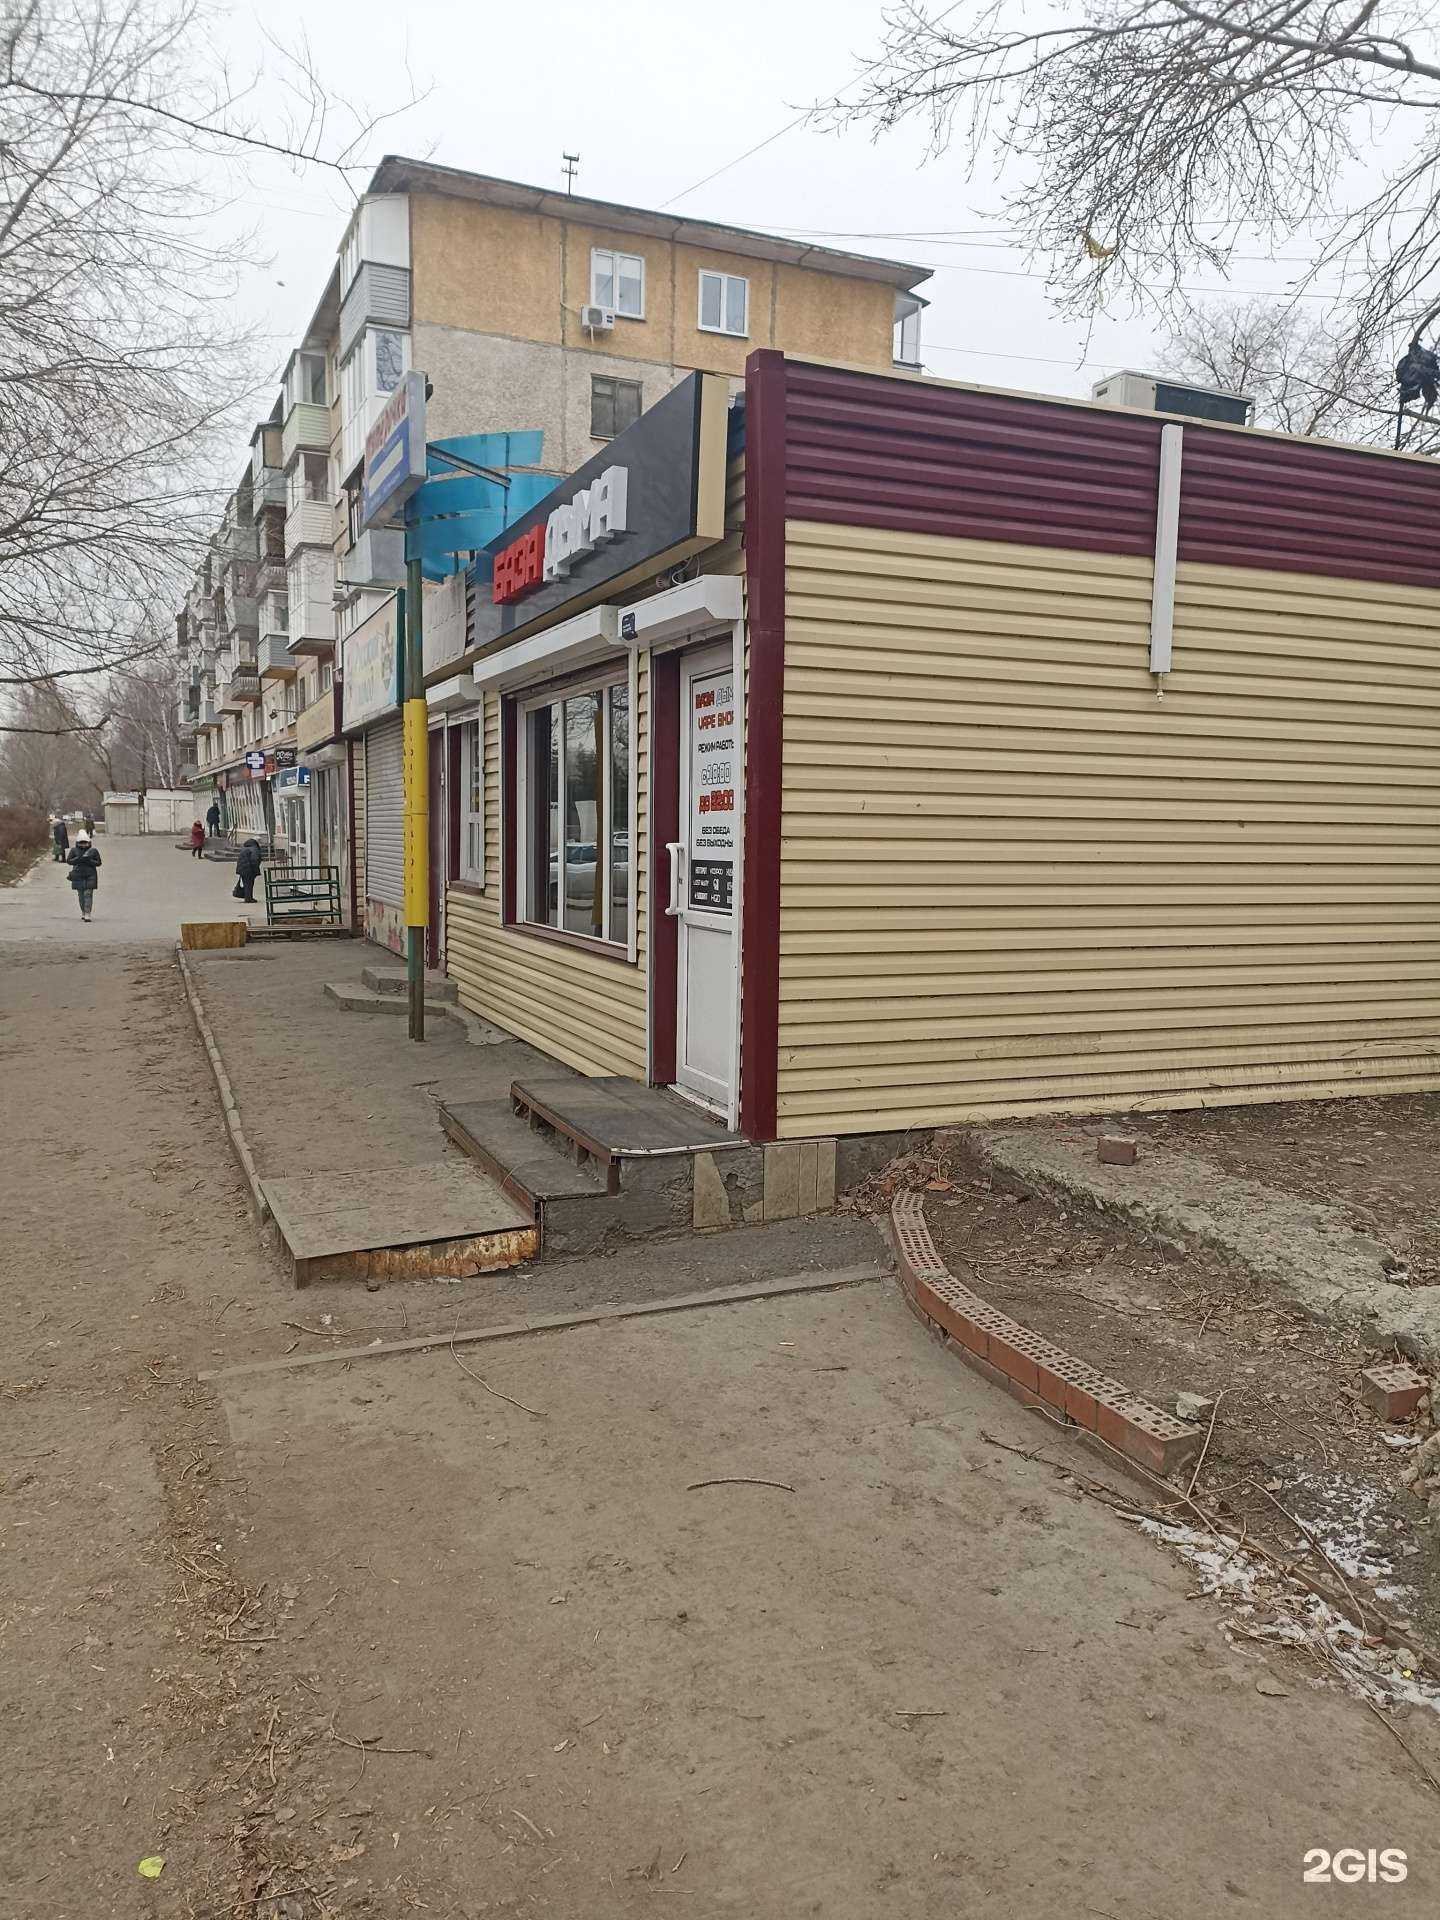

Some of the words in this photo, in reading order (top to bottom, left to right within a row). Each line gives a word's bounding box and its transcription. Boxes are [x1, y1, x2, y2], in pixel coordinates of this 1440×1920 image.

[494, 524, 546, 604] БАЗА
[543, 465, 628, 582] ДЫМА
[698, 742, 716, 753] РЕЖИМ
[702, 826, 713, 835] БЕЗ
[713, 826, 730, 836] ОБЕДА
[696, 838, 706, 847] БЕЗ
